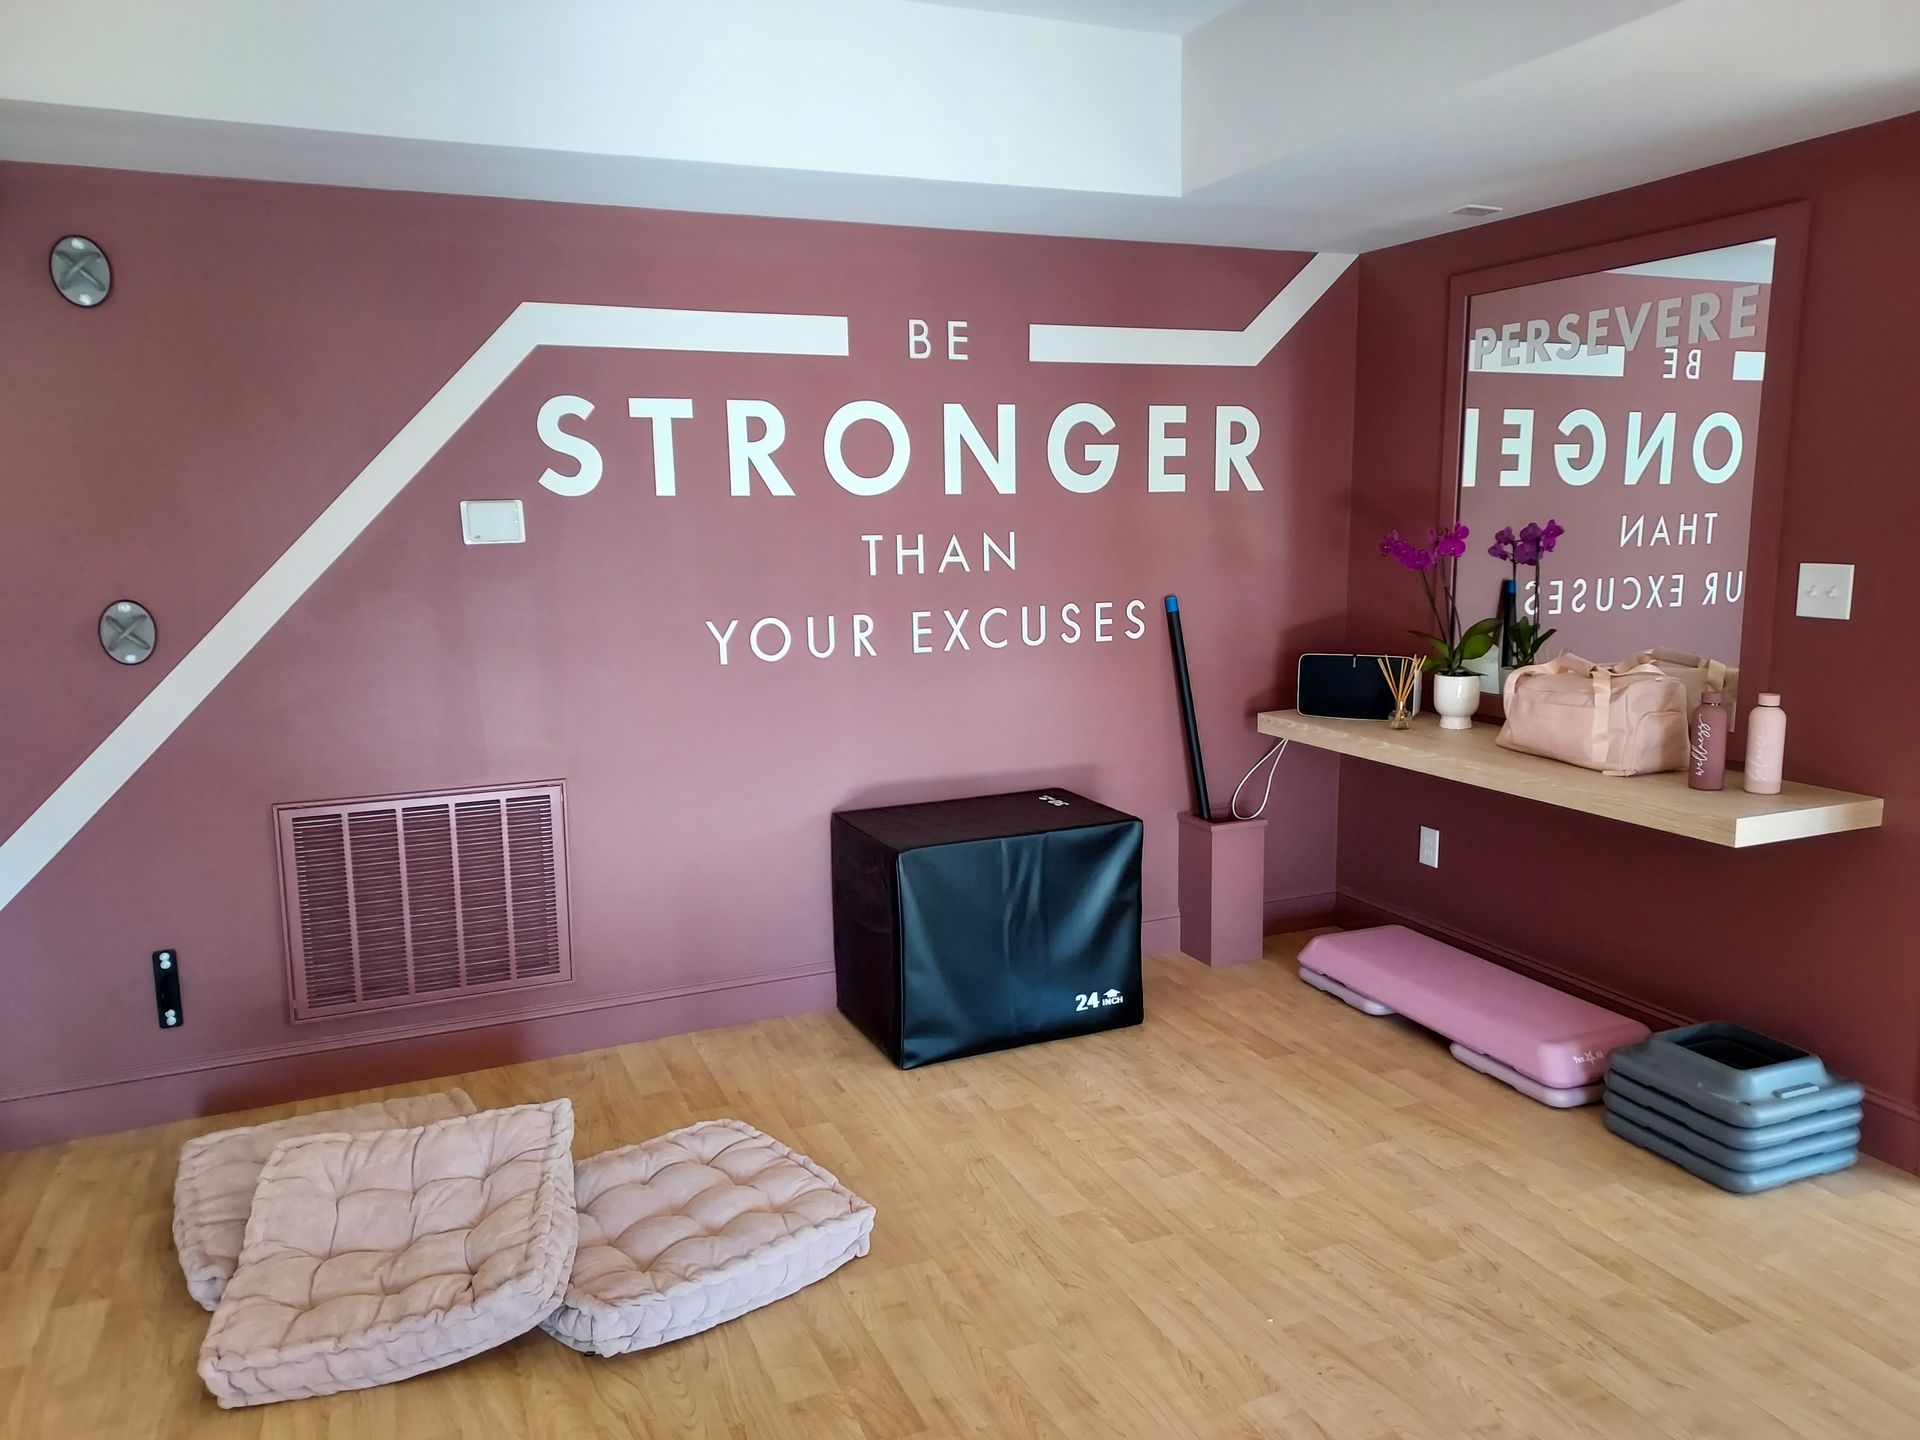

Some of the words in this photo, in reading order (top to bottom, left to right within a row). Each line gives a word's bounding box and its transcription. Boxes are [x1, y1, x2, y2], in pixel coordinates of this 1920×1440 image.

[908, 318, 969, 361] BE
[1473, 283, 1760, 370] PERSEVERE
[536, 394, 1264, 498] STRONGER
[861, 531, 1018, 576] THAN
[706, 613, 877, 666] YOUR
[912, 599, 1147, 654] EXCUSES
[1691, 713, 1711, 777] wellness
[1075, 991, 1100, 1012] 24
[1102, 995, 1124, 1007] INCH
